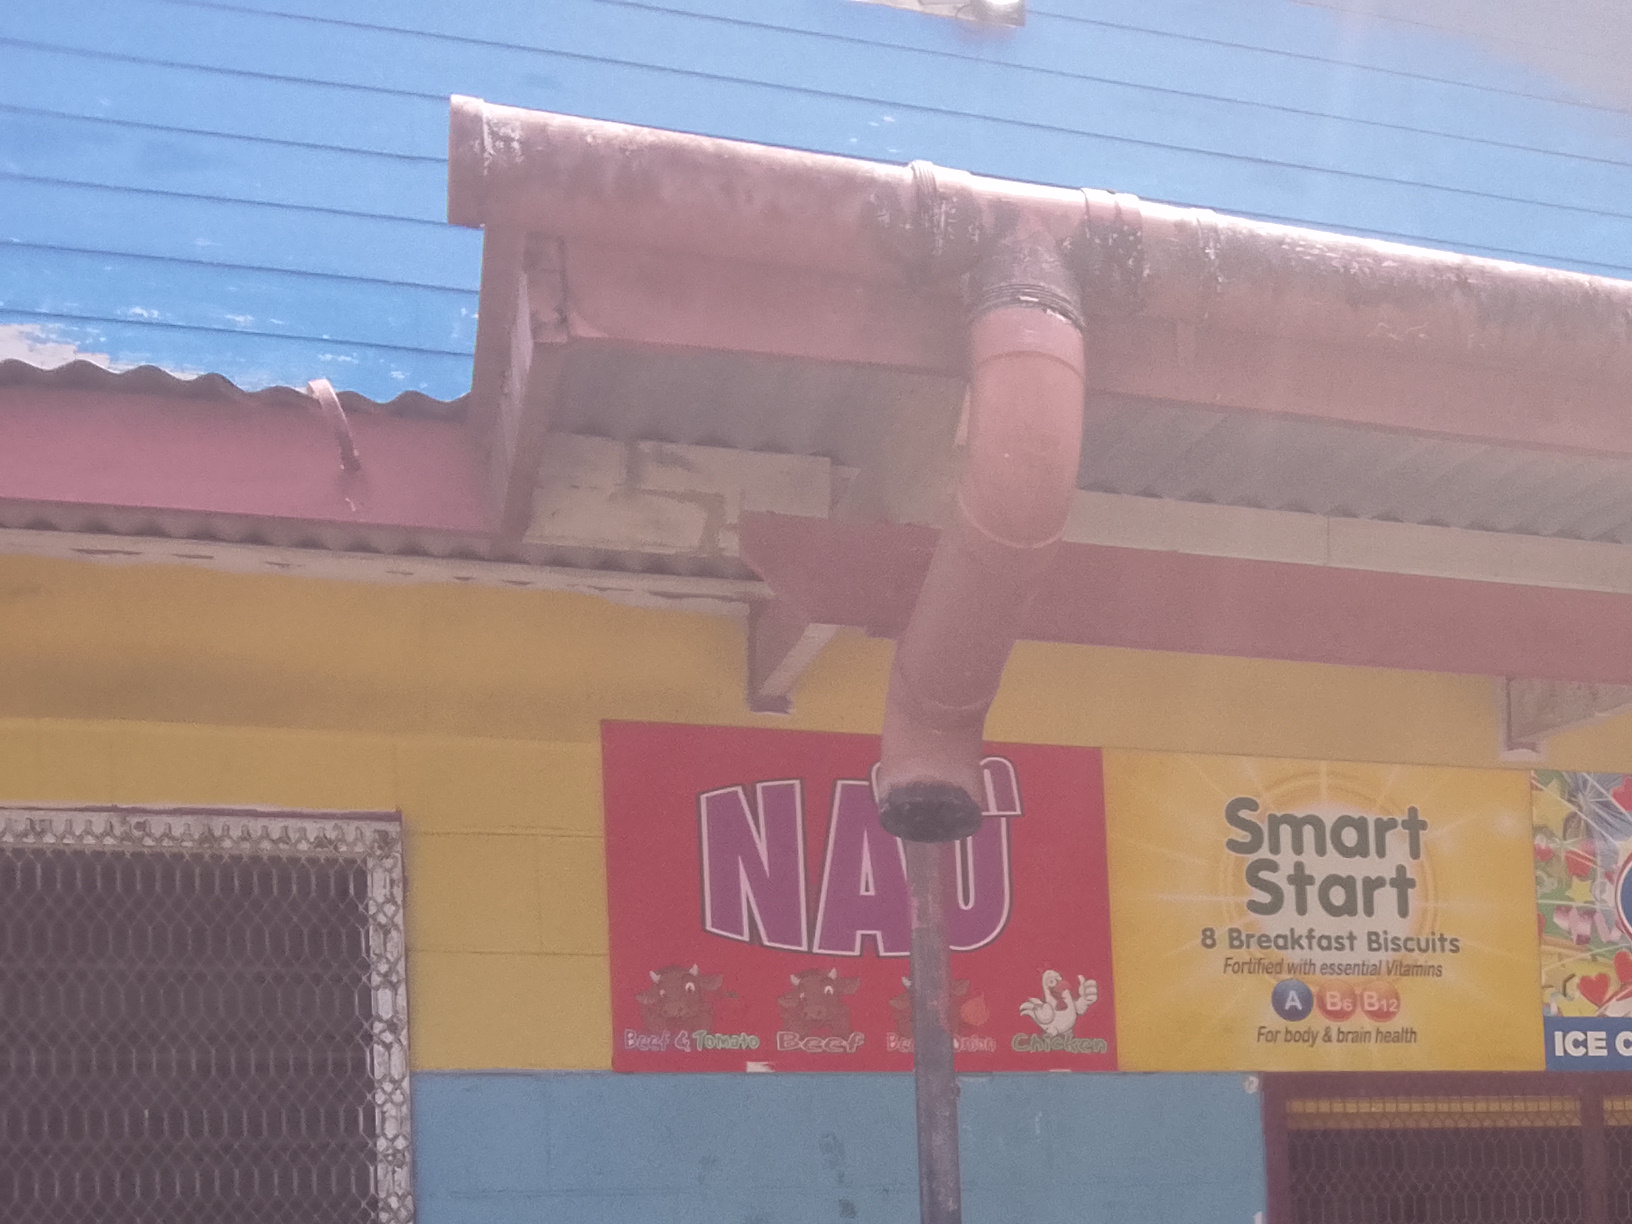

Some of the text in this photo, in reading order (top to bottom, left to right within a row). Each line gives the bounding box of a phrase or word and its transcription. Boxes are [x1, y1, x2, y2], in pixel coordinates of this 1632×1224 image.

[1224, 796, 1428, 860] Smart
[1245, 858, 1417, 919] Start
[1201, 927, 1461, 954] 8 Breakfast Biscuits
[1223, 957, 1443, 978] Fortified with essential Vitamins
[1284, 990, 1303, 1011] A
[624, 1029, 670, 1050] Beef
[692, 1029, 760, 1050] Tomato
[776, 1031, 865, 1053] Beef
[1011, 1032, 1107, 1054] Chicken
[1257, 1026, 1417, 1047] For body & brain health
[1554, 1031, 1607, 1057] ICE
